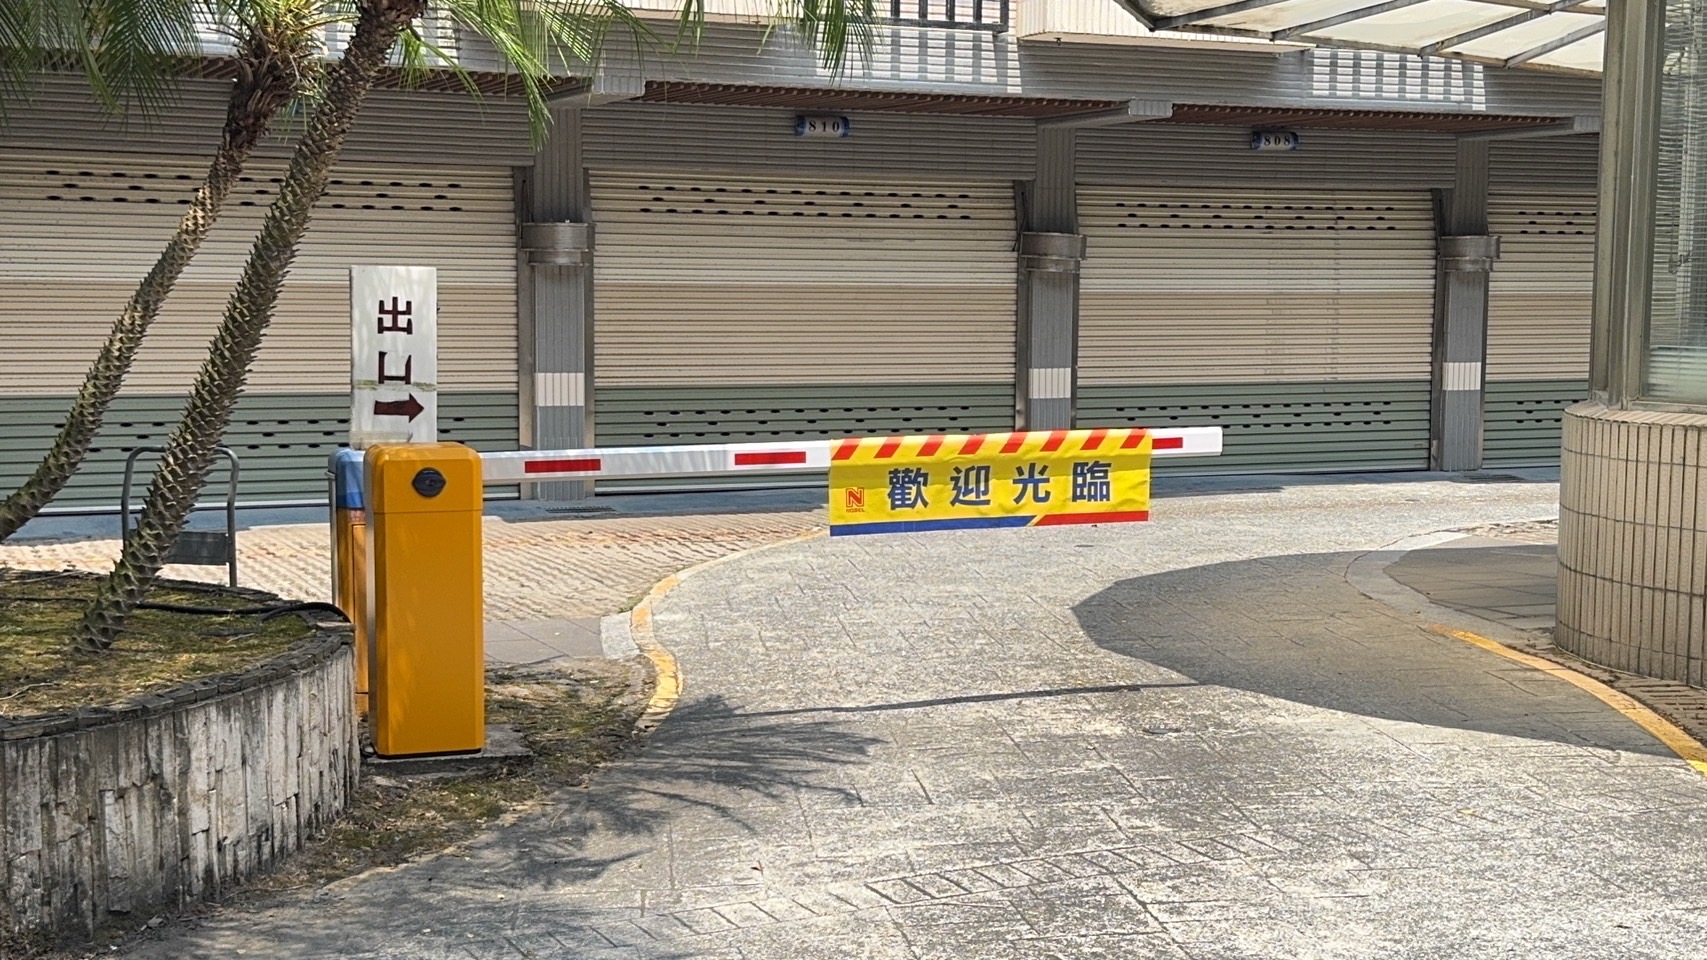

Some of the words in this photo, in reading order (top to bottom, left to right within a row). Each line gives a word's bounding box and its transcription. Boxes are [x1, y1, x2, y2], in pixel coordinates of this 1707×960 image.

[808, 120, 840, 132] 810
[1263, 135, 1291, 147] 808
[886, 460, 1112, 511] 歡迎光臨
